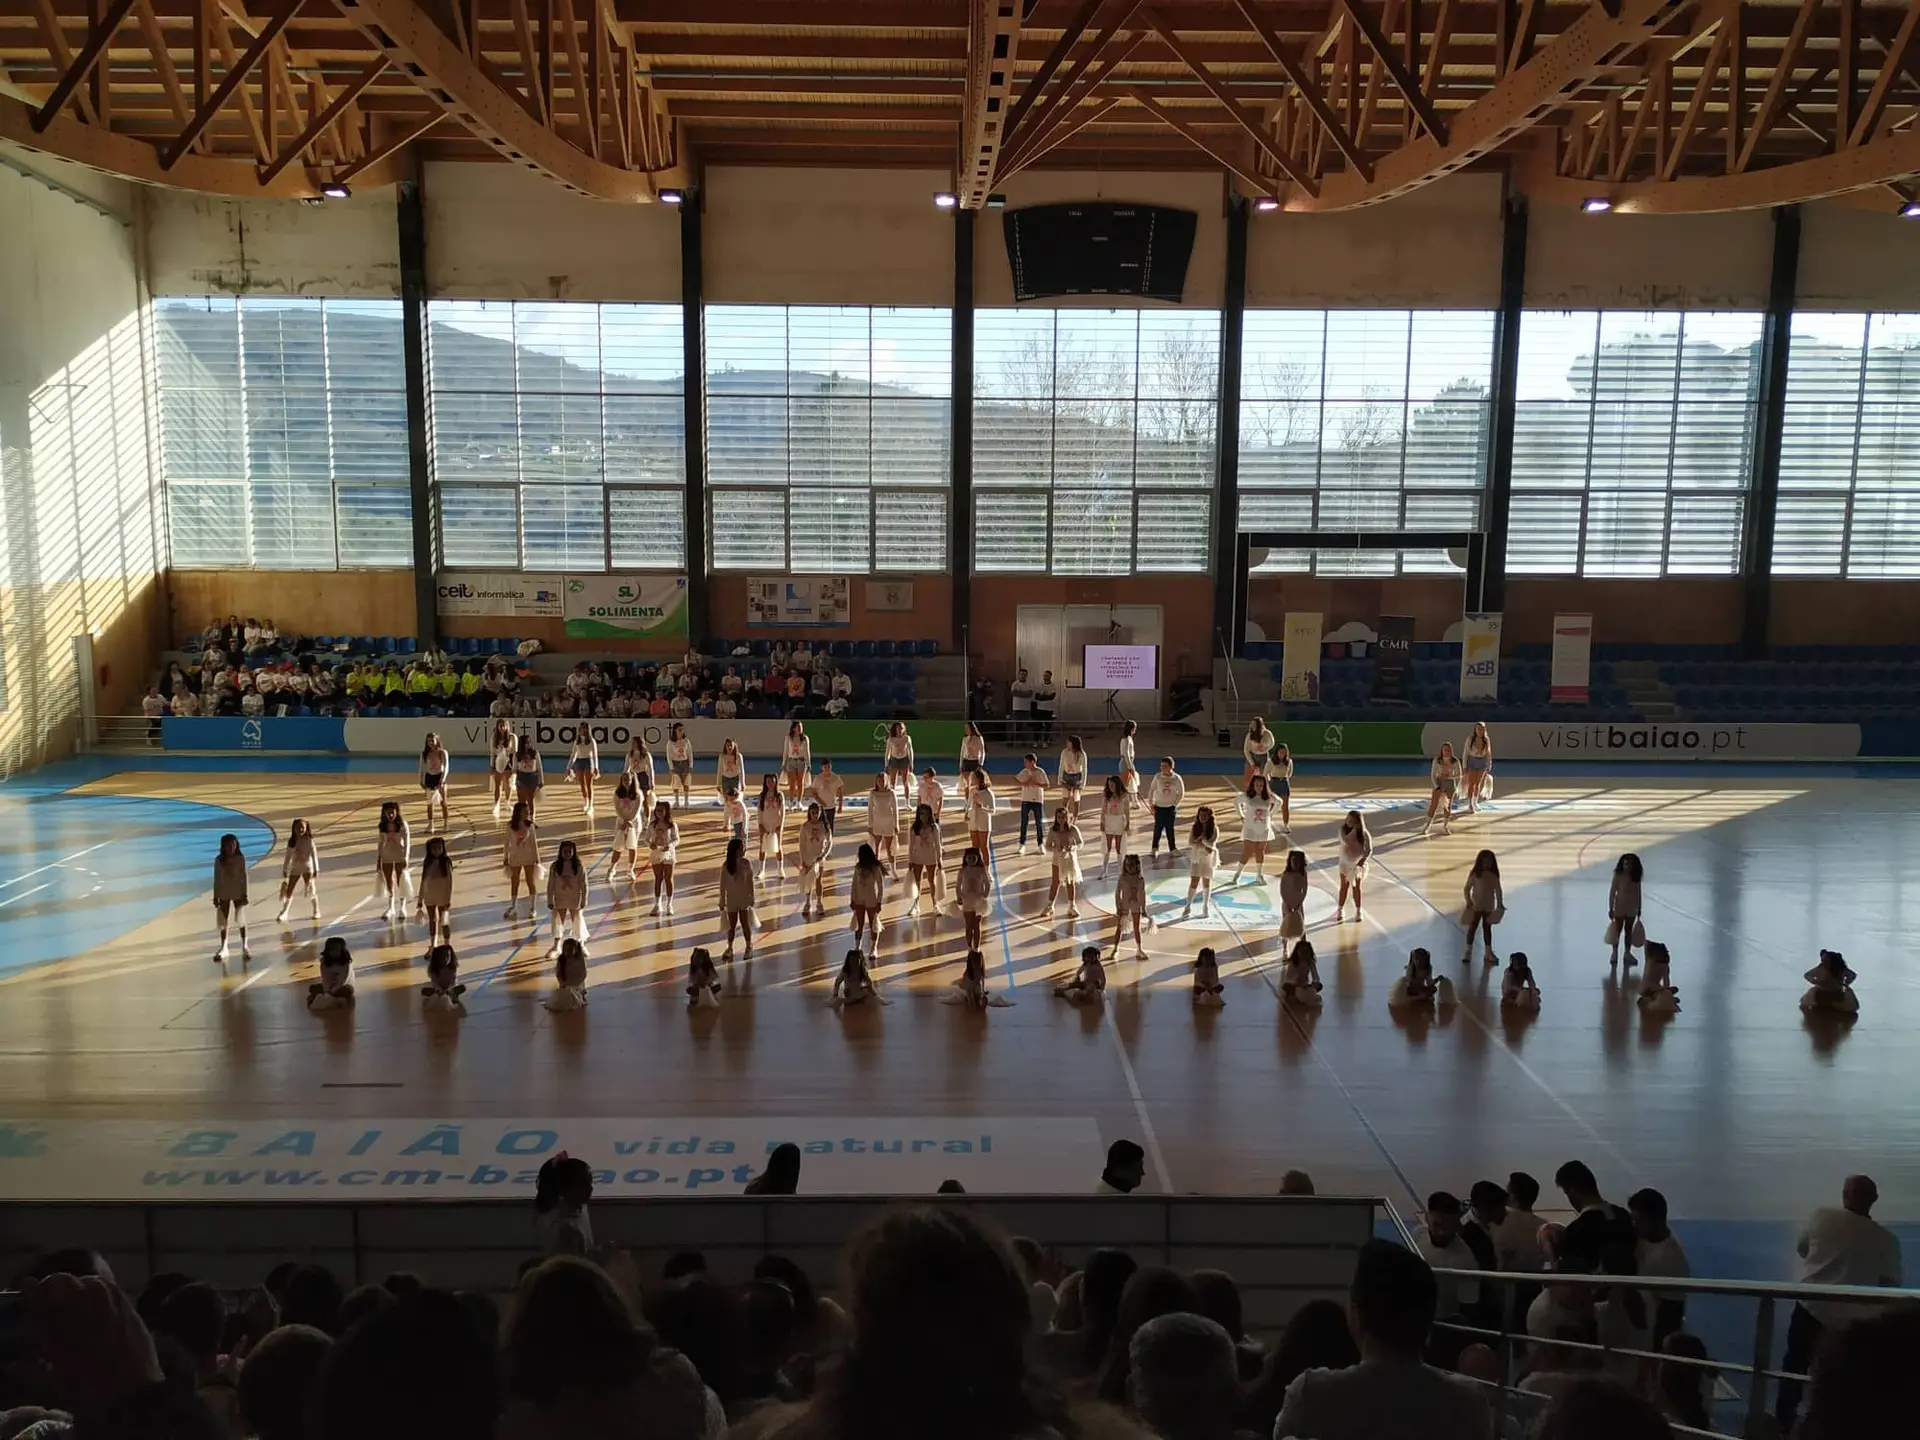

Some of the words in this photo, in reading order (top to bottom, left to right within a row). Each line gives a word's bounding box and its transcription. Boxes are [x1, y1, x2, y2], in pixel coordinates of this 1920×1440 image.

[588, 606, 665, 617] SOLIMENTA
[1379, 639, 1409, 650] CMR
[1466, 660, 1495, 677] AEB
[463, 719, 674, 747] viitbaaopt
[1538, 725, 1747, 752] visitbaiao.pt
[166, 1124, 561, 1158] BAIÃO
[613, 1135, 736, 1155] vida
[143, 1164, 756, 1189] www.cm-baao.pt
